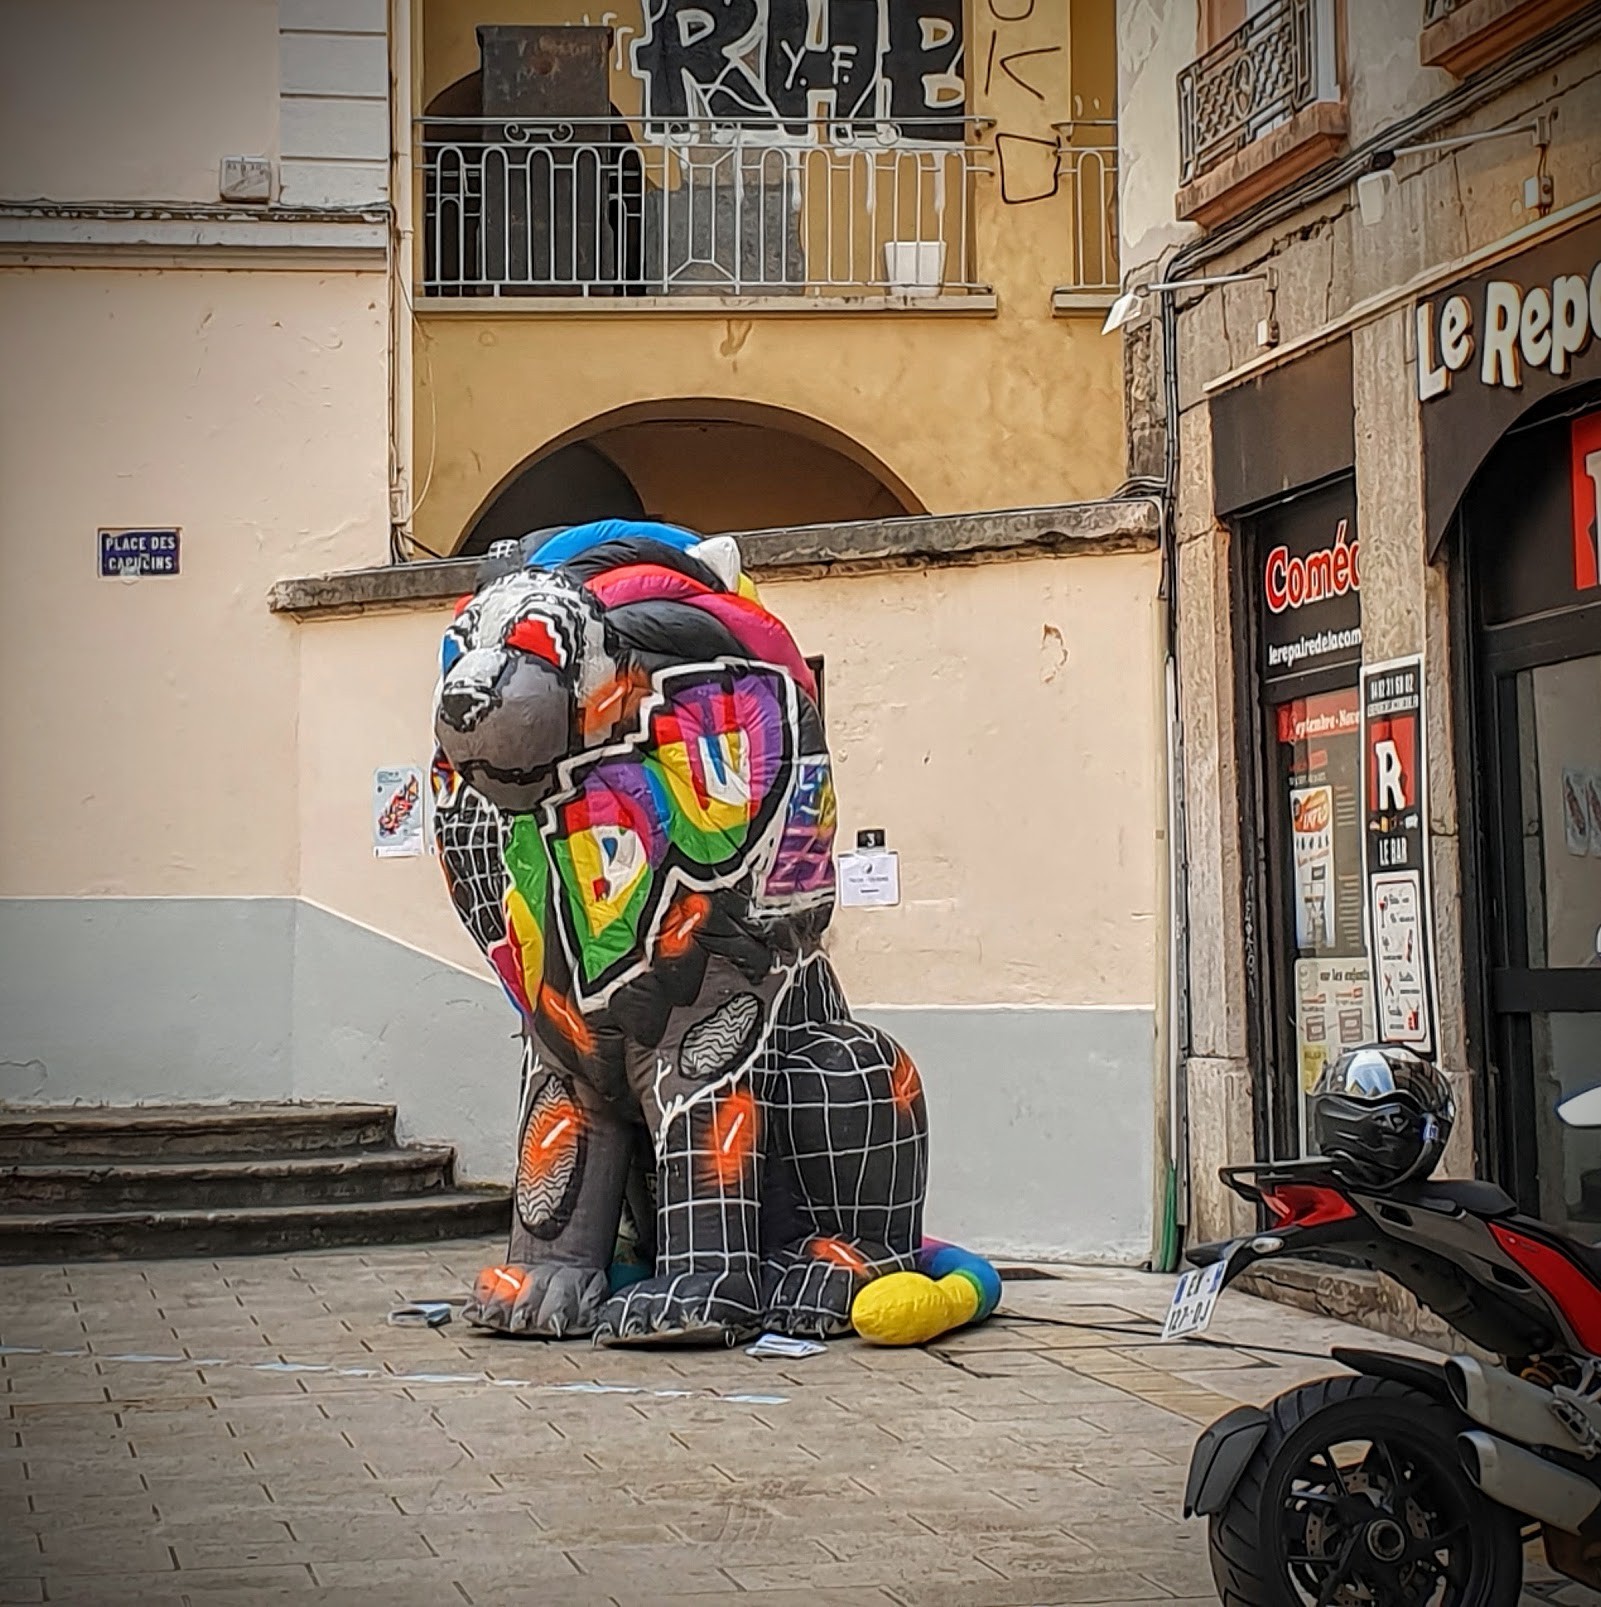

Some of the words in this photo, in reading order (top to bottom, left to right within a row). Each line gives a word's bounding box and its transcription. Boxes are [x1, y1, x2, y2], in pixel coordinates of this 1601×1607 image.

[1417, 295, 1474, 402] Le
[106, 537, 147, 551] PLACE
[151, 536, 176, 551] DES
[1375, 739, 1406, 811] R
[1379, 838, 1389, 866] LE
[1391, 836, 1408, 865] BAR
